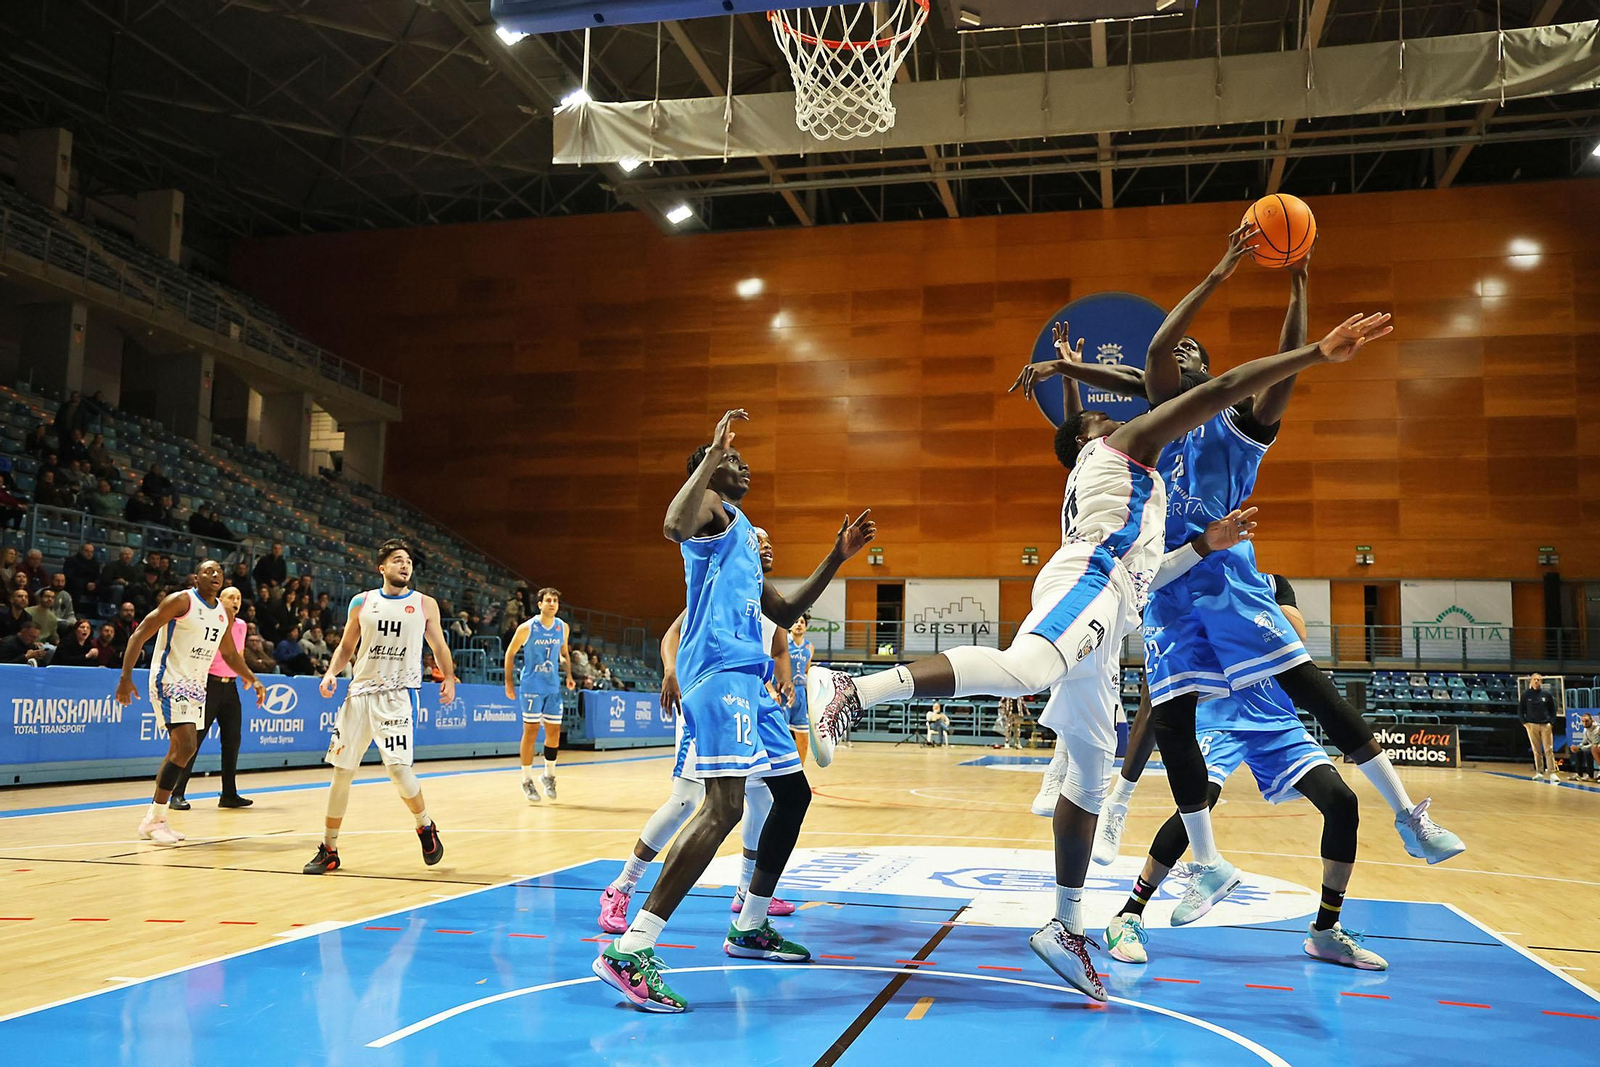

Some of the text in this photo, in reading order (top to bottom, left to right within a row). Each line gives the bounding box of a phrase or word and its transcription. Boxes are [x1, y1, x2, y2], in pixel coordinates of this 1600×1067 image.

[1087, 394, 1133, 403] HUELVA
[204, 627, 220, 642] 13
[377, 620, 402, 638] 44
[913, 622, 991, 635] GESTIA
[369, 645, 407, 658] MELILLA
[545, 647, 551, 659] 7
[528, 699, 533, 711] 7
[435, 717, 467, 727] GESTIA
[474, 710, 482, 721] La
[14, 724, 86, 735] TOTAL TRANSPORT
[249, 719, 304, 733] HYUNDAI
[733, 711, 753, 746] 12
[385, 735, 407, 751] 44
[1410, 729, 1451, 746] eleva
[1200, 736, 1213, 756] 6
